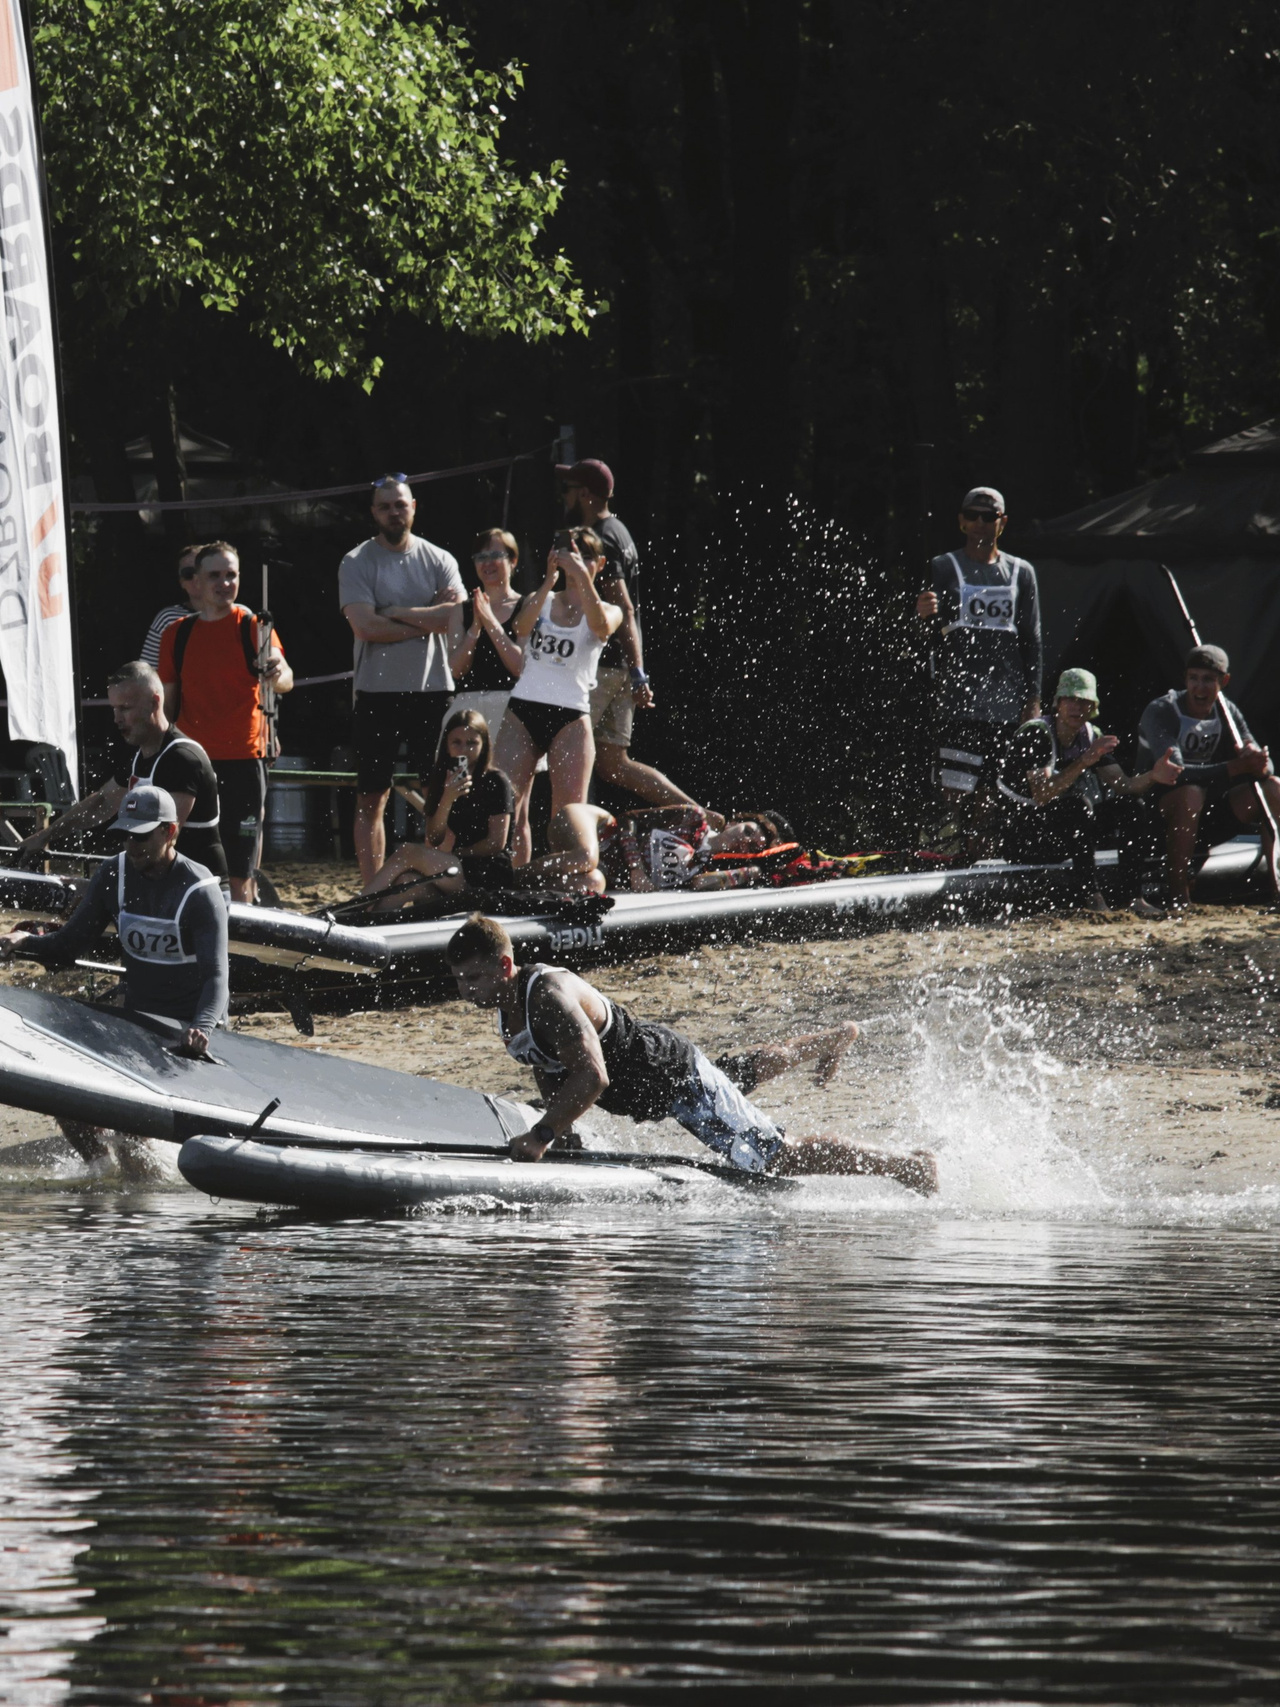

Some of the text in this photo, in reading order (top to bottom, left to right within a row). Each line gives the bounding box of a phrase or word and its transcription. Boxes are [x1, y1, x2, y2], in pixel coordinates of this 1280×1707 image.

[969, 597, 1013, 618] 063
[530, 630, 576, 659] 030
[127, 929, 181, 954] 072
[547, 925, 607, 952] TIGER
